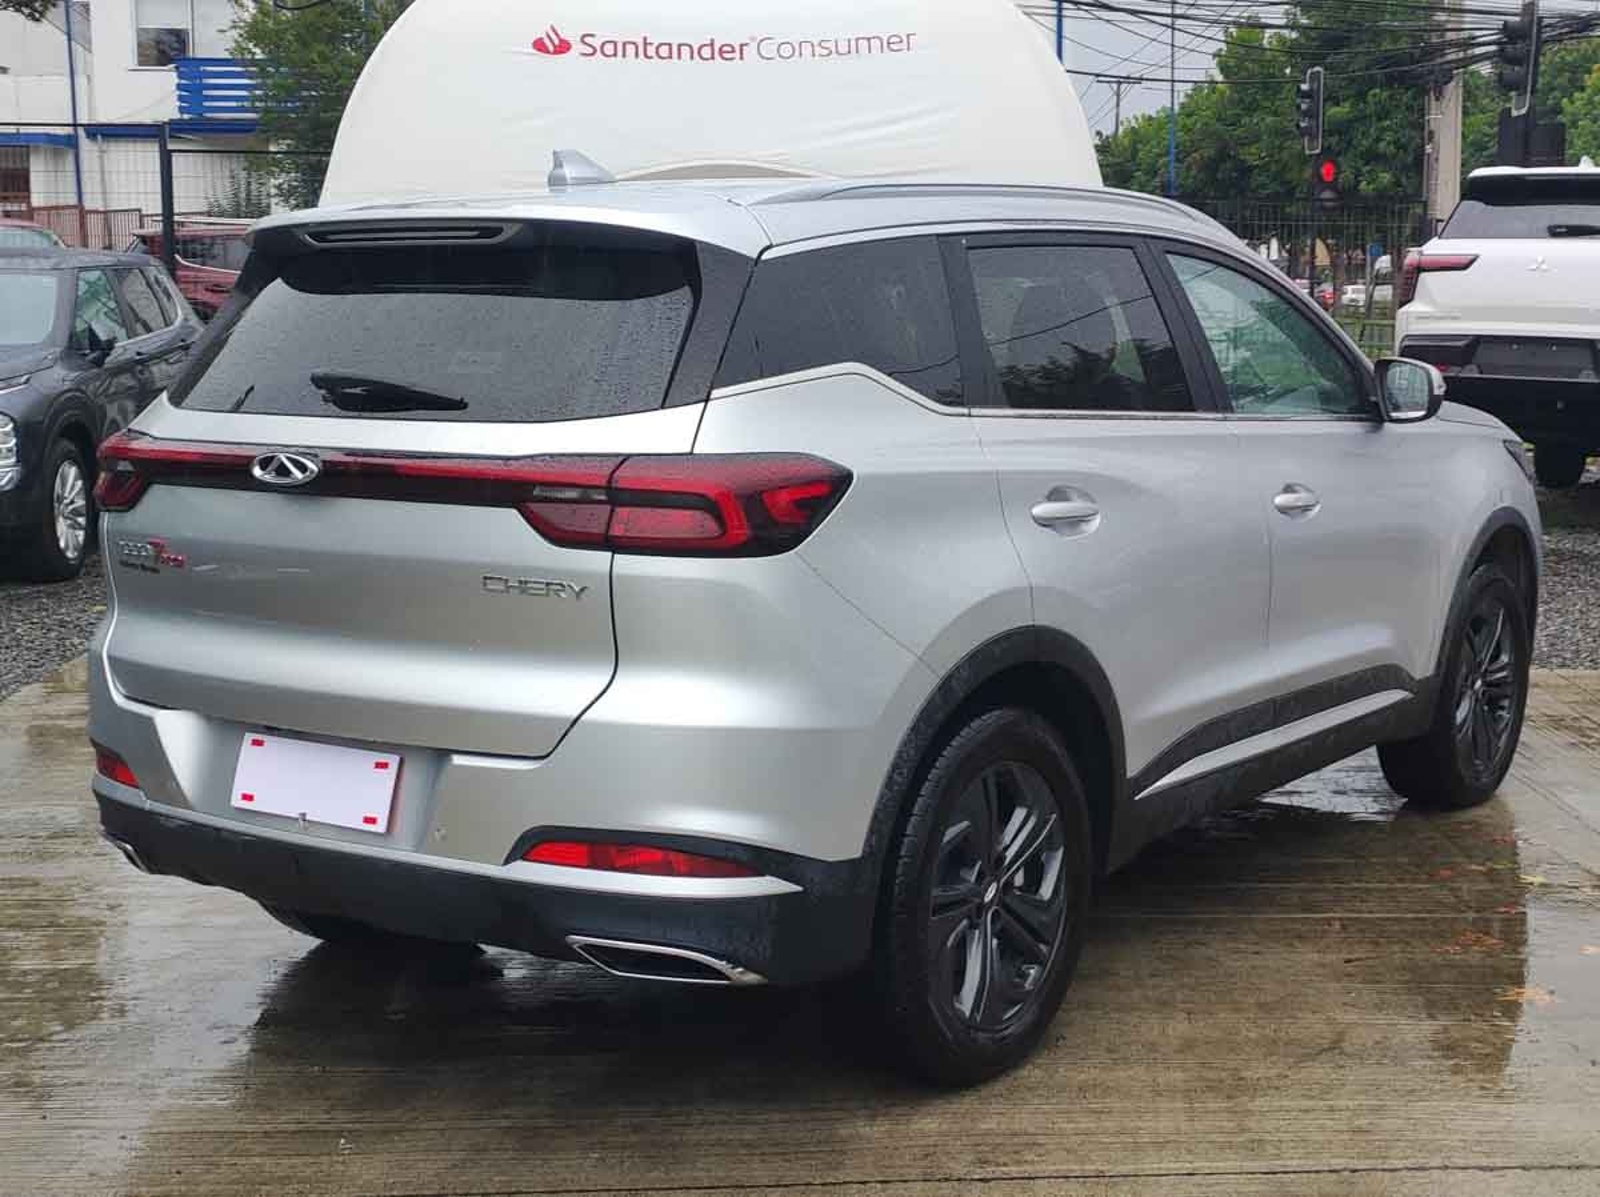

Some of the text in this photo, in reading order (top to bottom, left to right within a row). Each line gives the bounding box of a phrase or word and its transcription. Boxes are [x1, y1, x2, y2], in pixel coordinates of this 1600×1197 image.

[579, 32, 917, 61] Santander Consumer
[481, 575, 588, 600] CHERY
